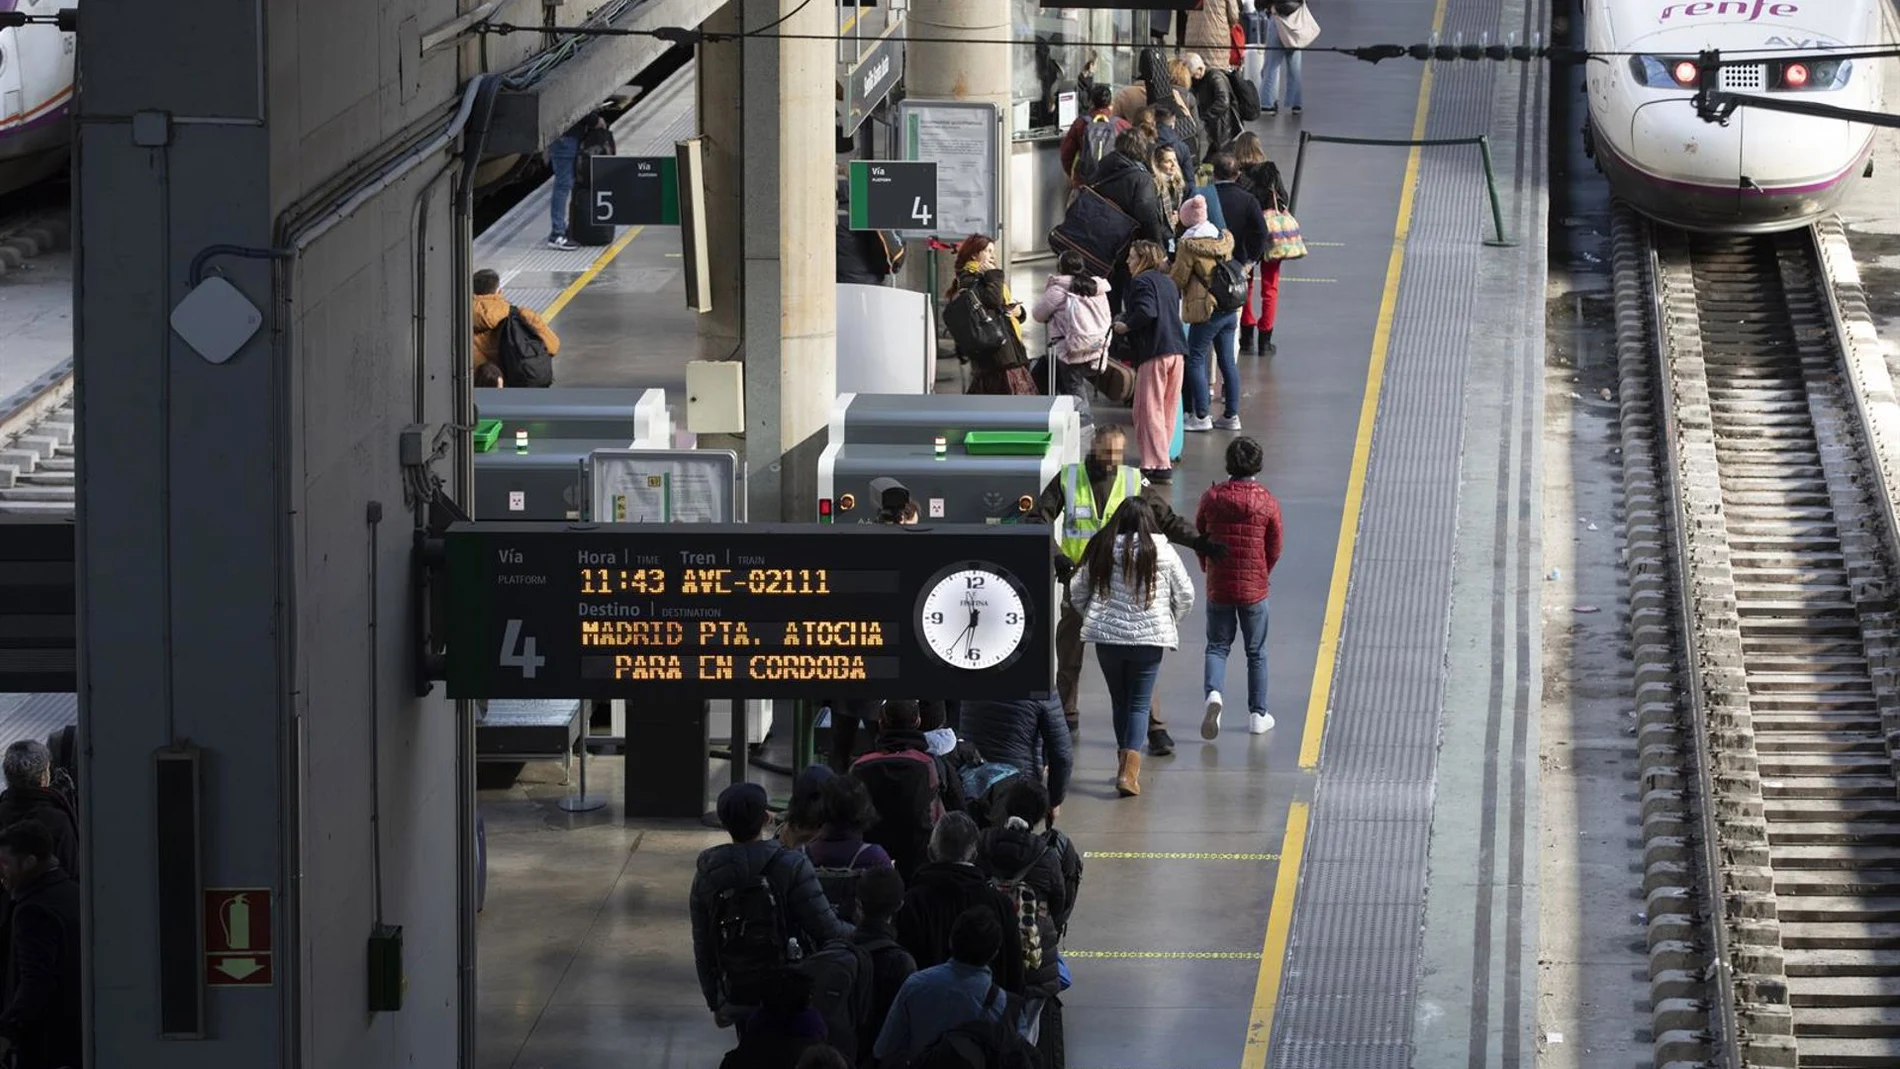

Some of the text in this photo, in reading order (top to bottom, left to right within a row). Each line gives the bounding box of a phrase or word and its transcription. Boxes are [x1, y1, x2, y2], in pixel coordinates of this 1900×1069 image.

[1658, 0, 1798, 24] renfe
[637, 162, 651, 171] Vía
[872, 167, 885, 175] Vía
[597, 191, 613, 220] 5
[911, 196, 933, 225] 4
[499, 549, 523, 563] Vía
[578, 551, 765, 565] Hora TIME Tren TRAIN
[499, 575, 546, 585] PLATFORM
[581, 569, 665, 593] 11:43
[965, 577, 985, 589] 12
[579, 602, 721, 617] Destino DESTINATION
[931, 612, 943, 624] 9
[1006, 612, 1018, 624] 3
[582, 621, 883, 645] MADRID PTA. ATOCHA
[500, 619, 545, 678] 4
[968, 649, 980, 660] 6
[615, 655, 682, 679] PARA
[750, 655, 866, 679] CORDOBA
